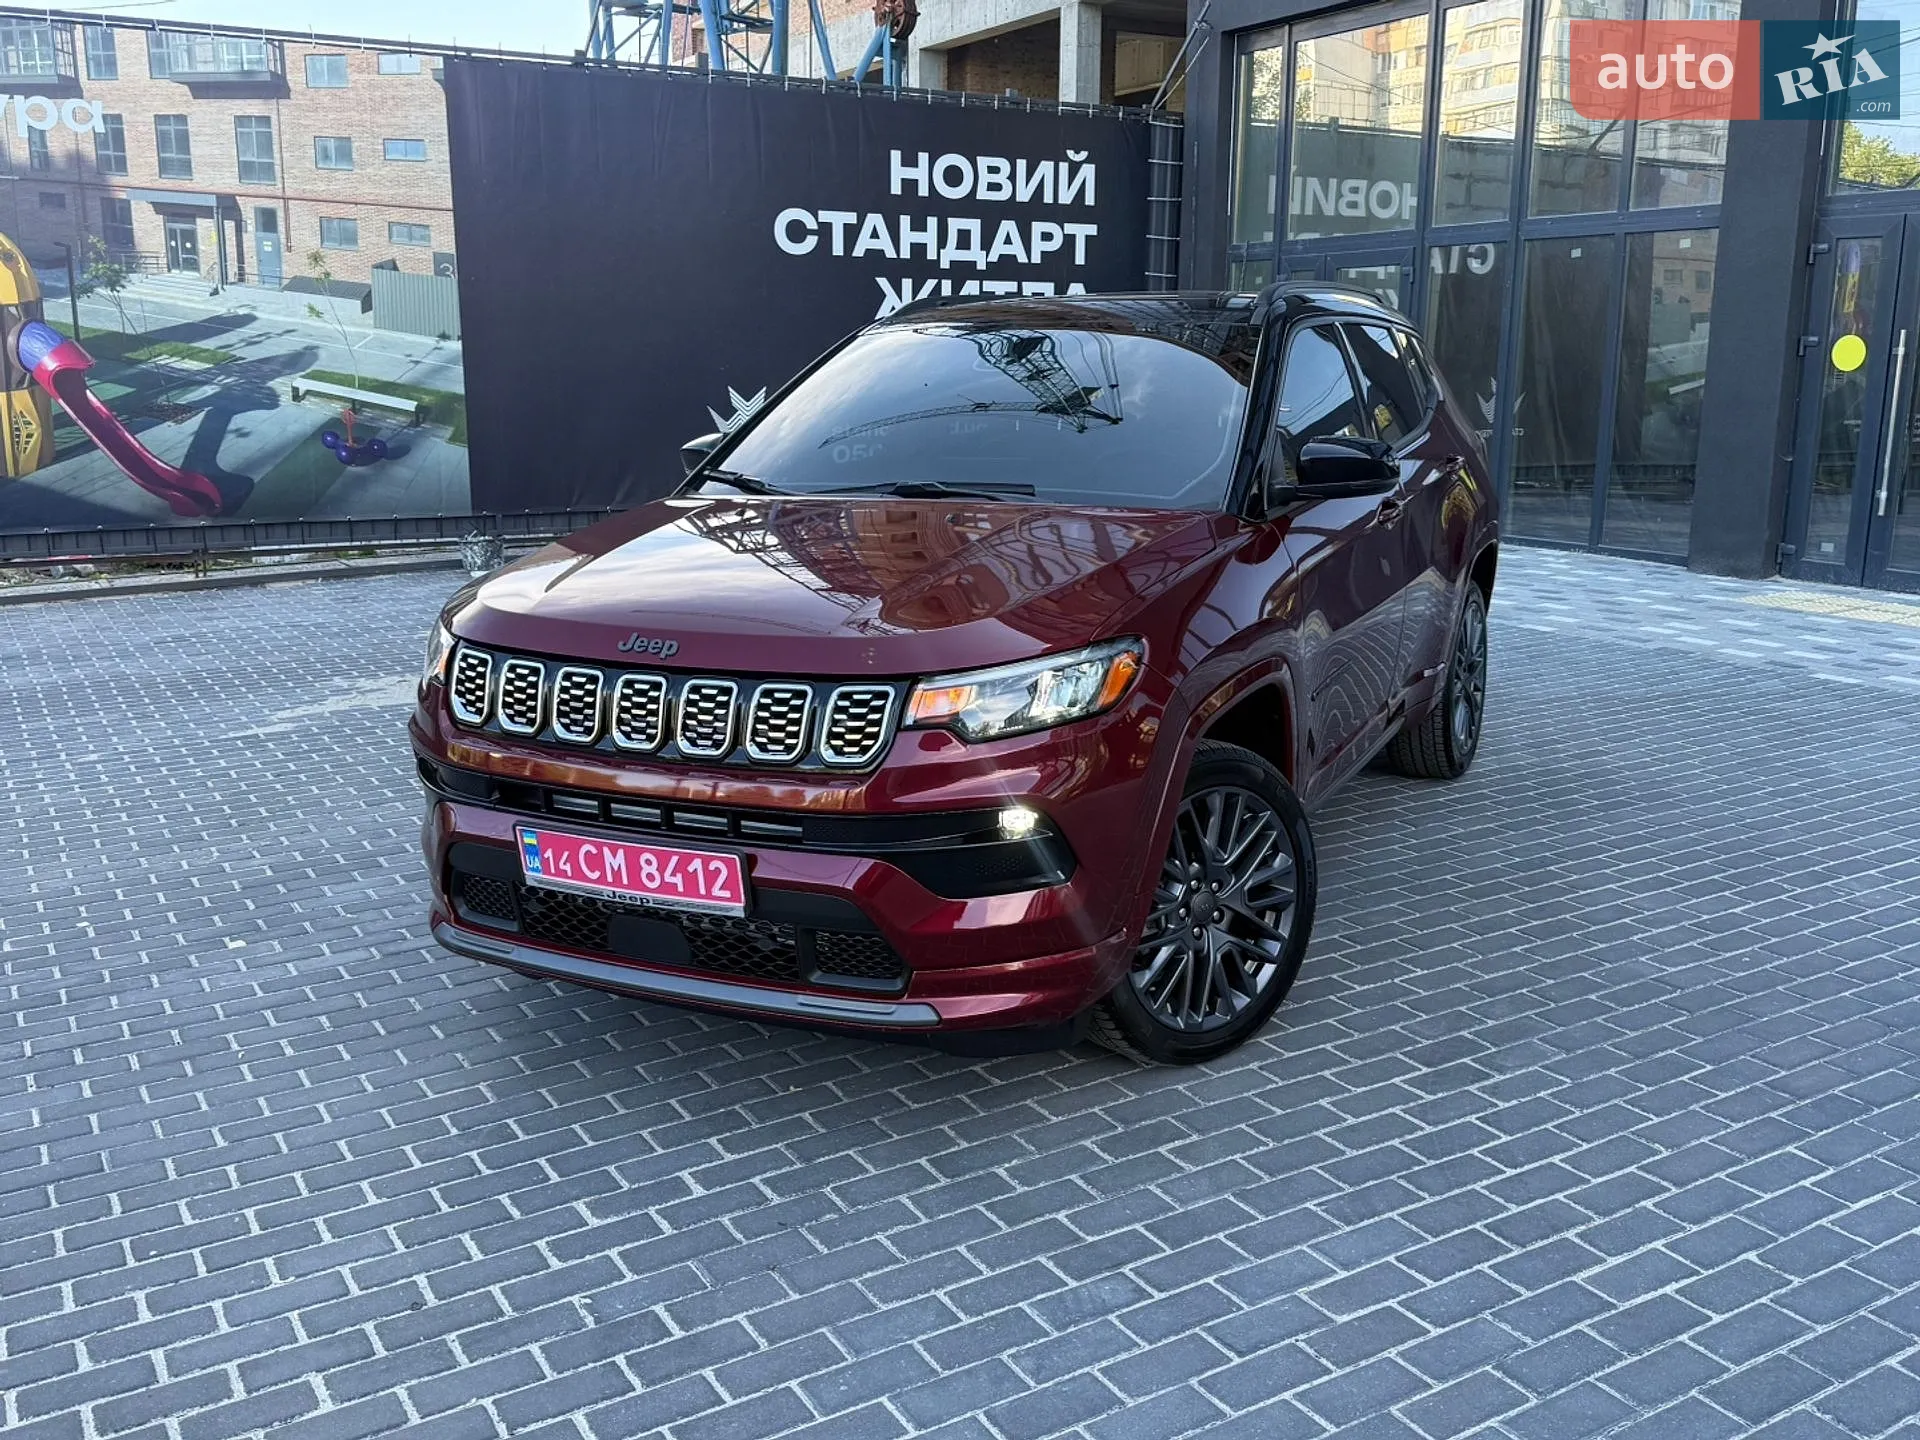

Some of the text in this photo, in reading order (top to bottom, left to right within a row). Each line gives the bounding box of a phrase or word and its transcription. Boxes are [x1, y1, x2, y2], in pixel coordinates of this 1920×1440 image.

[0, 94, 106, 138] ра
[890, 149, 1096, 206] НОВИЙ
[773, 207, 1098, 270] СТАНДАРТ
[617, 631, 679, 660] Jeep
[525, 854, 543, 871] UA
[639, 851, 732, 898] 8412
[605, 889, 651, 906] Jeep
